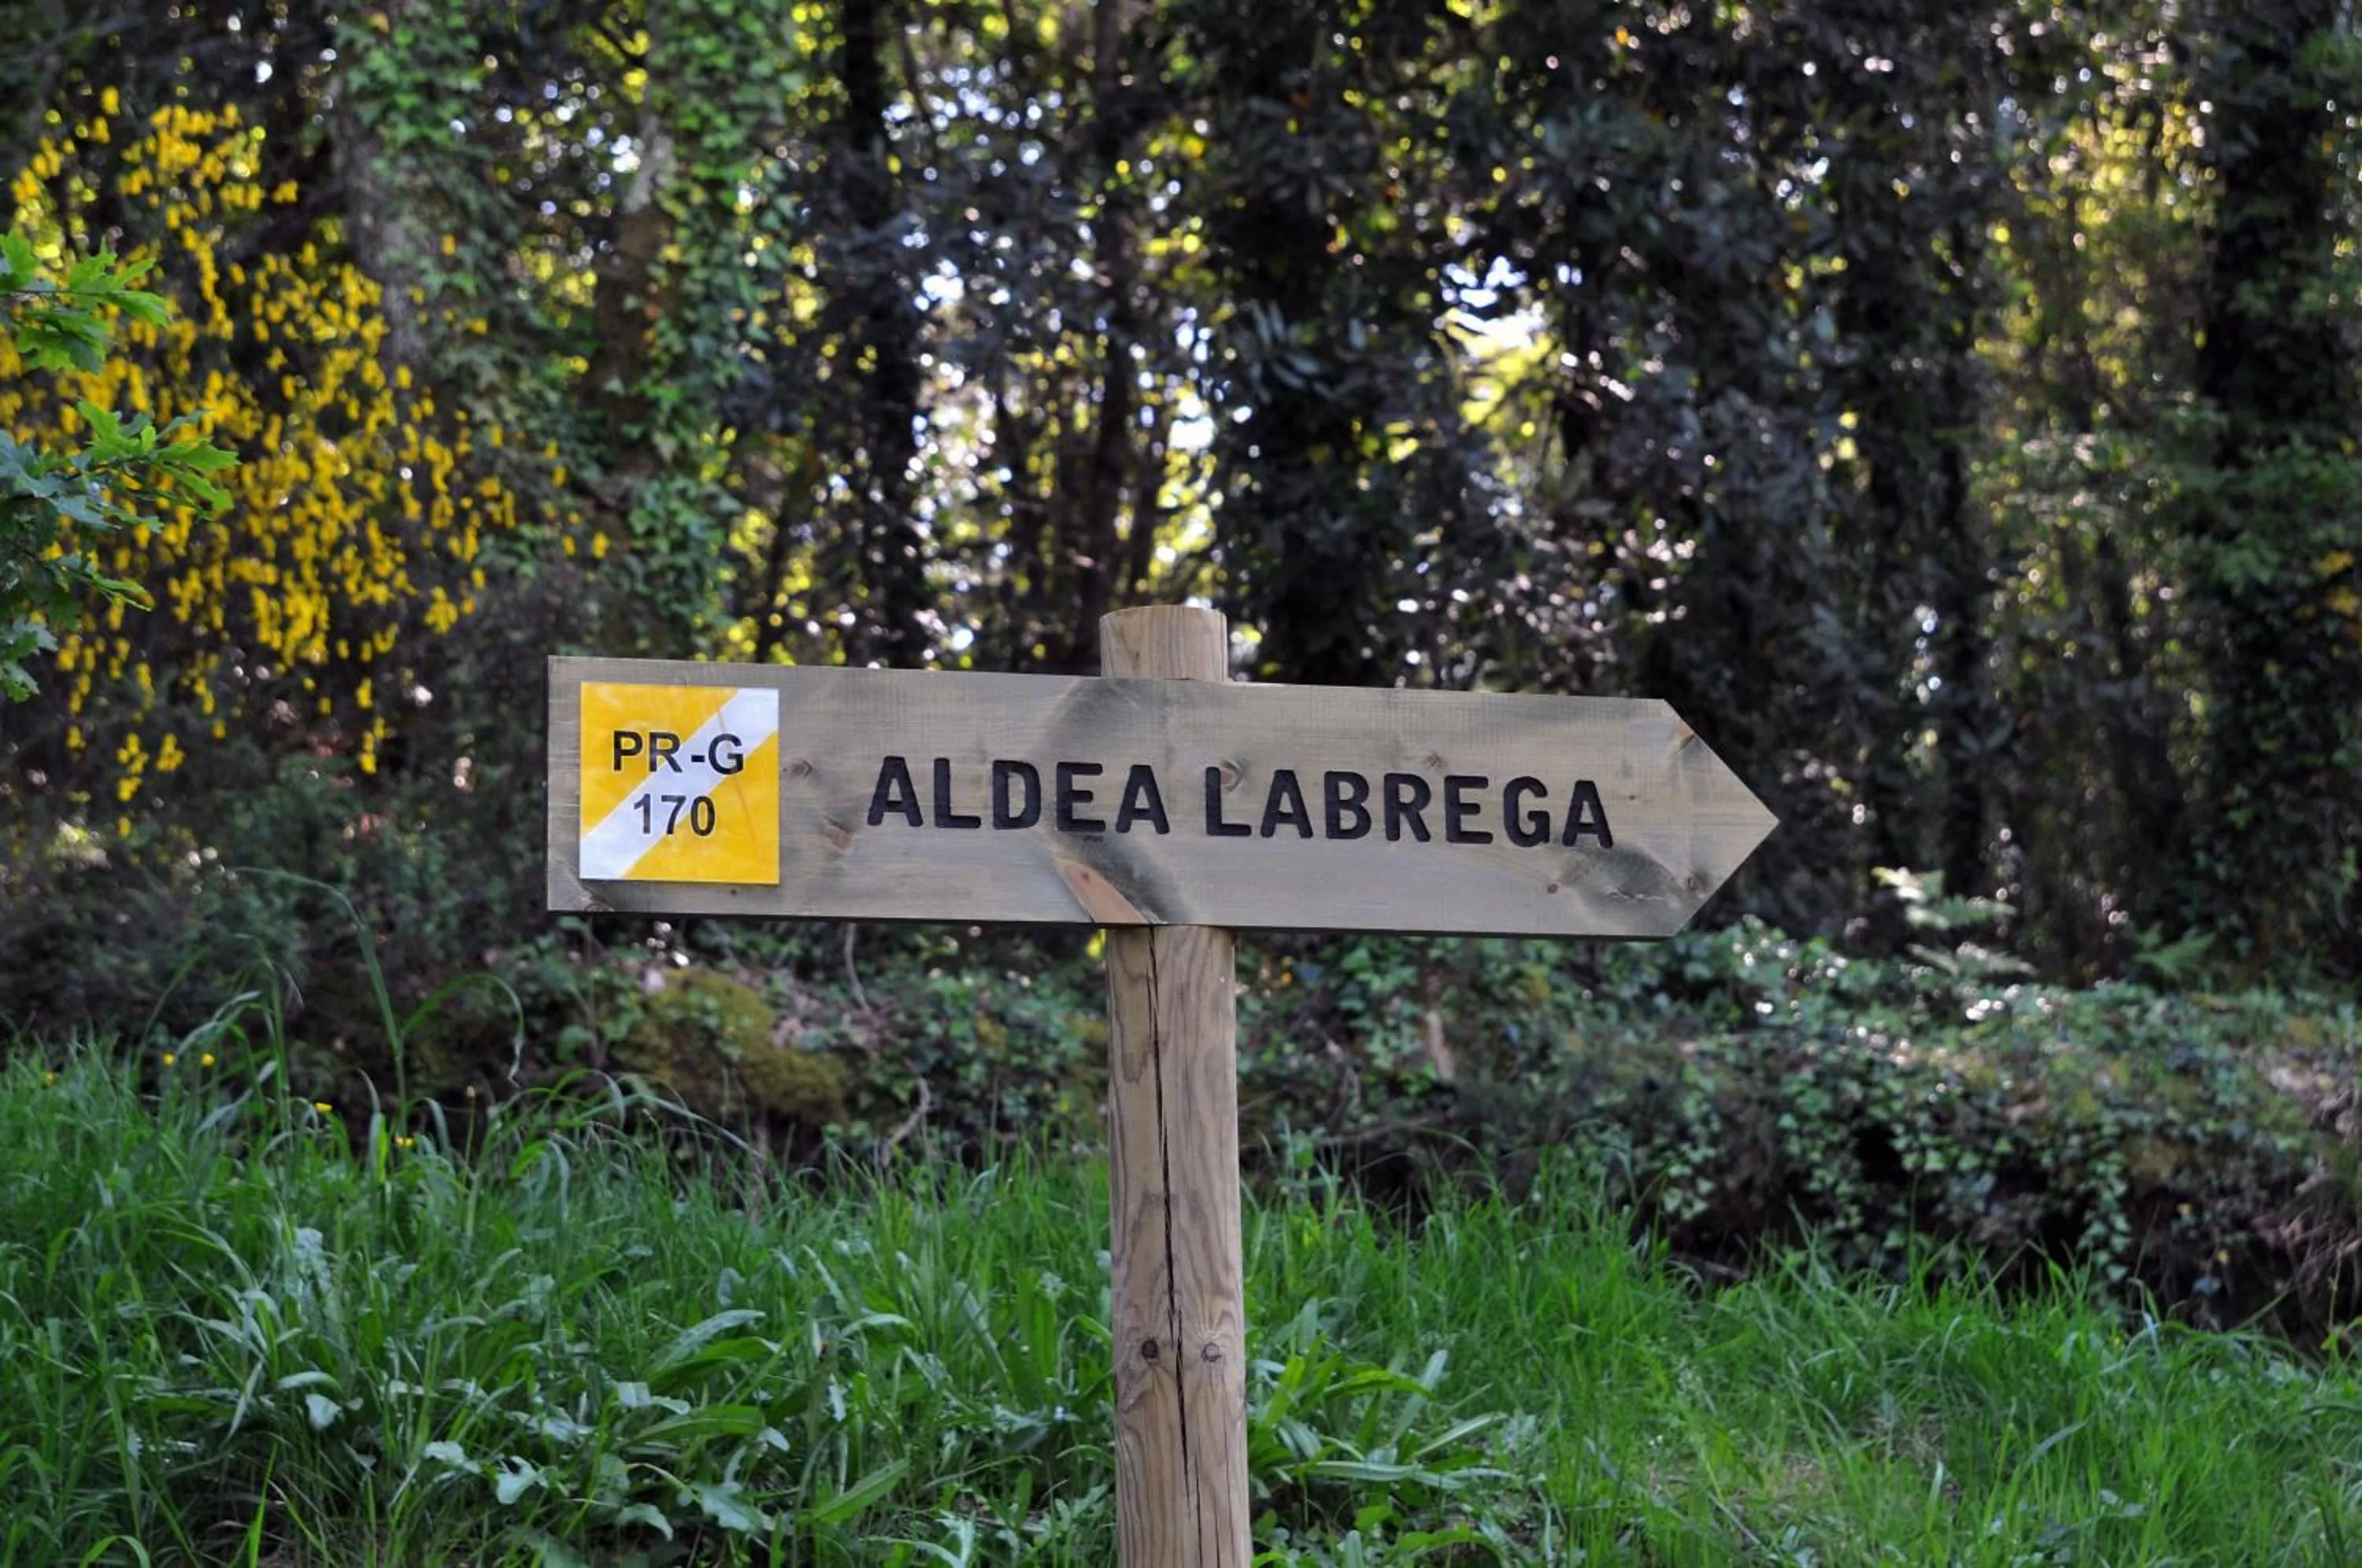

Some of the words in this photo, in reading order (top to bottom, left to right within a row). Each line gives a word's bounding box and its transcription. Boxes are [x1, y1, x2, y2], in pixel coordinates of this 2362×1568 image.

[613, 730, 745, 775] PR-G
[633, 793, 716, 837] 170
[866, 755, 1171, 835] ALDEA
[1205, 765, 1615, 850] LABREGA
